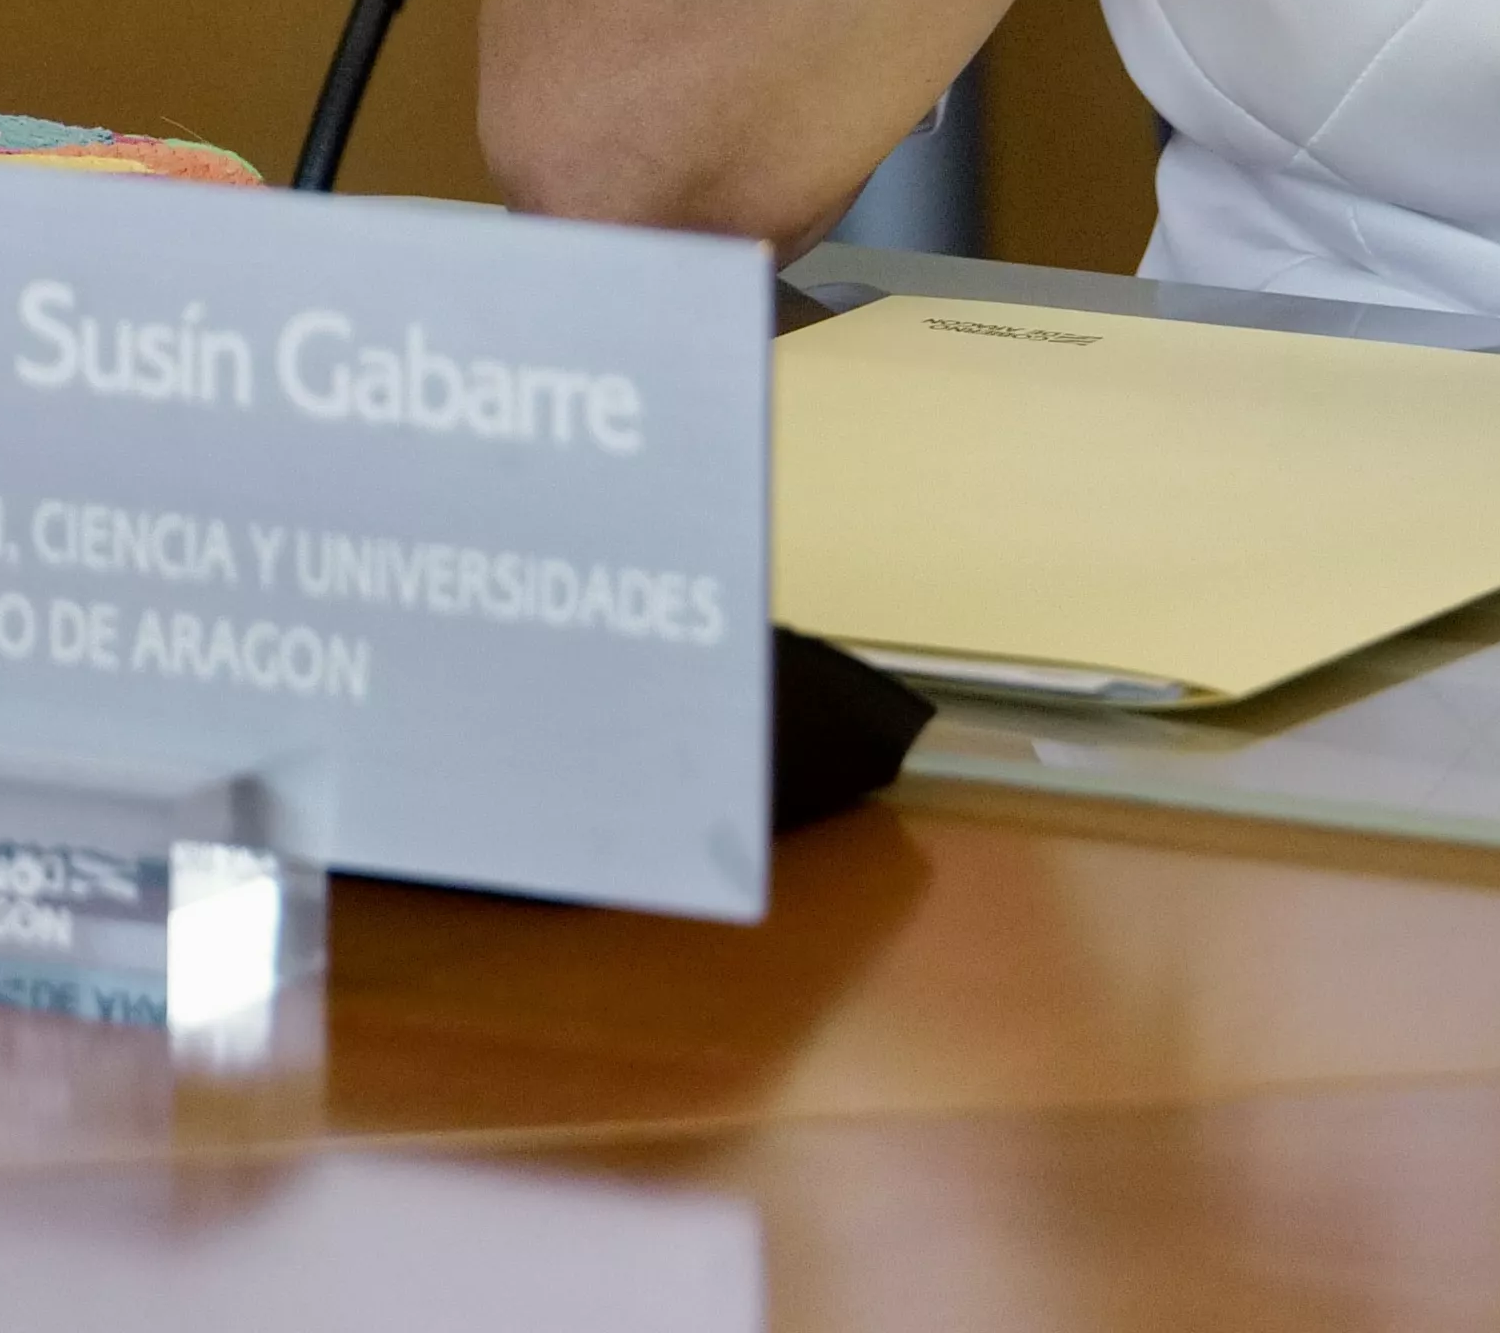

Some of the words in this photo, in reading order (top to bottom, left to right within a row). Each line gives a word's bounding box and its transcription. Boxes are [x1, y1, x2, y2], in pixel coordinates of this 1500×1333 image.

[13, 278, 255, 407] Susín
[274, 309, 645, 455] Gabarre
[31, 498, 238, 589] CIENCIA
[247, 523, 287, 590] Y
[296, 528, 727, 647] UNIVERSIDADES
[49, 598, 121, 673] DE
[132, 609, 370, 703] ARAGON
